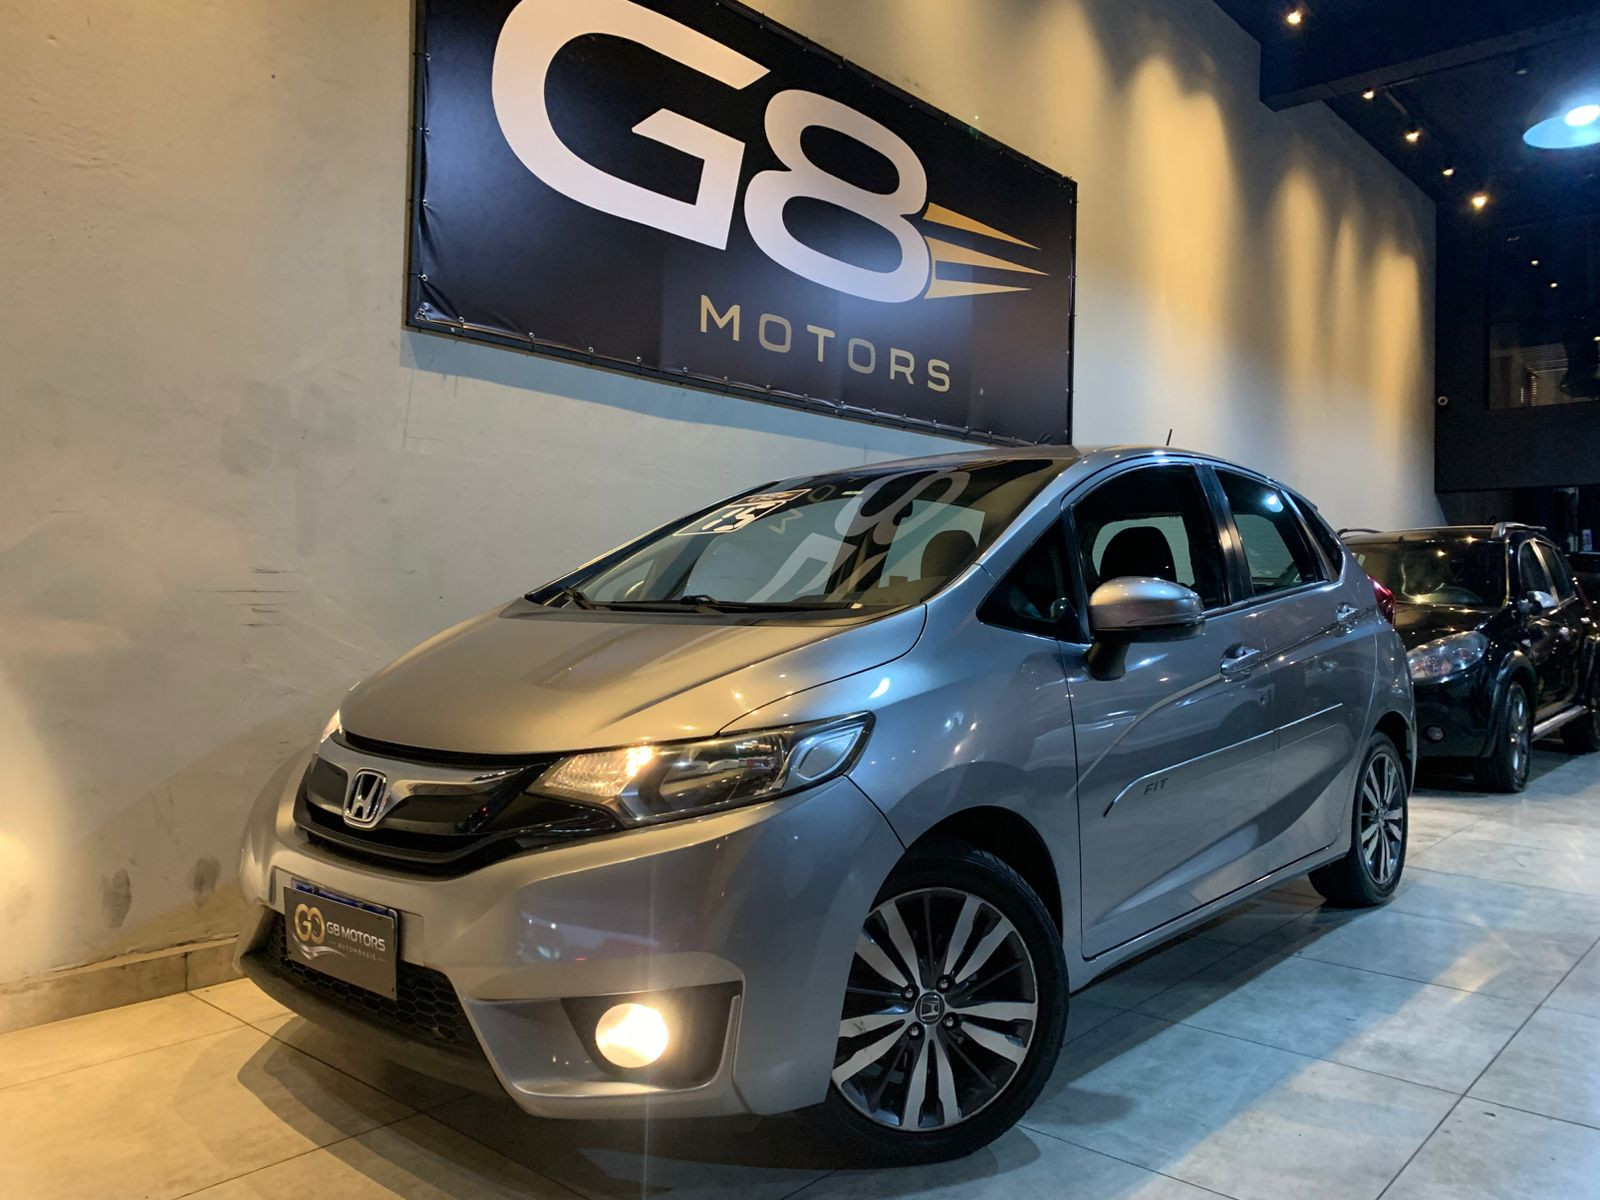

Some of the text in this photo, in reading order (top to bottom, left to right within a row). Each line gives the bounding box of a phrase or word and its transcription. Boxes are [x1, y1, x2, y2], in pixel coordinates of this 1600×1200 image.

[491, 0, 932, 303] G8
[700, 294, 951, 394] MOTORS
[1143, 778, 1168, 795] FIT
[341, 927, 386, 952] MOTORS
